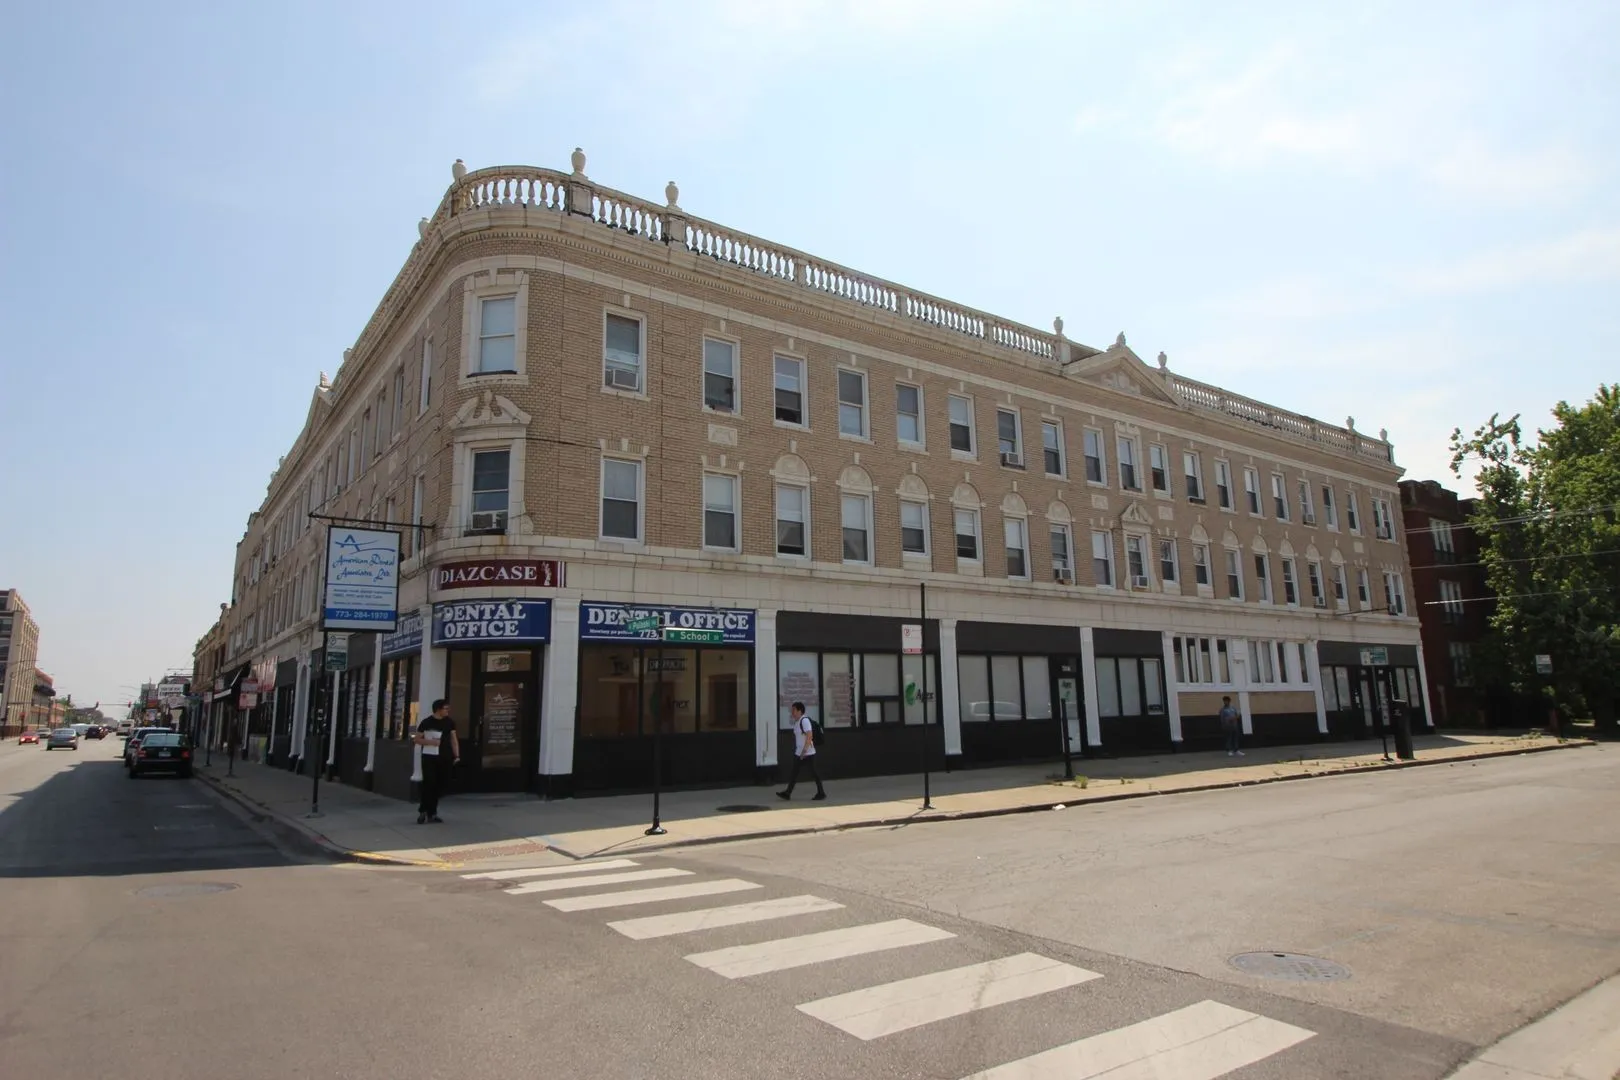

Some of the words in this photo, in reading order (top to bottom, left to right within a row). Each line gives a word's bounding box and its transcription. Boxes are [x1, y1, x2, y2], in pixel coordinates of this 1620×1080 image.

[332, 554, 368, 568] American
[369, 553, 396, 567] Dental
[440, 566, 538, 584] DIAZCASE
[442, 604, 526, 622] DENTAL
[679, 612, 749, 630] OFFICE
[403, 616, 423, 635] OFFIC
[444, 620, 520, 639] OFFICE
[680, 631, 710, 641] School
